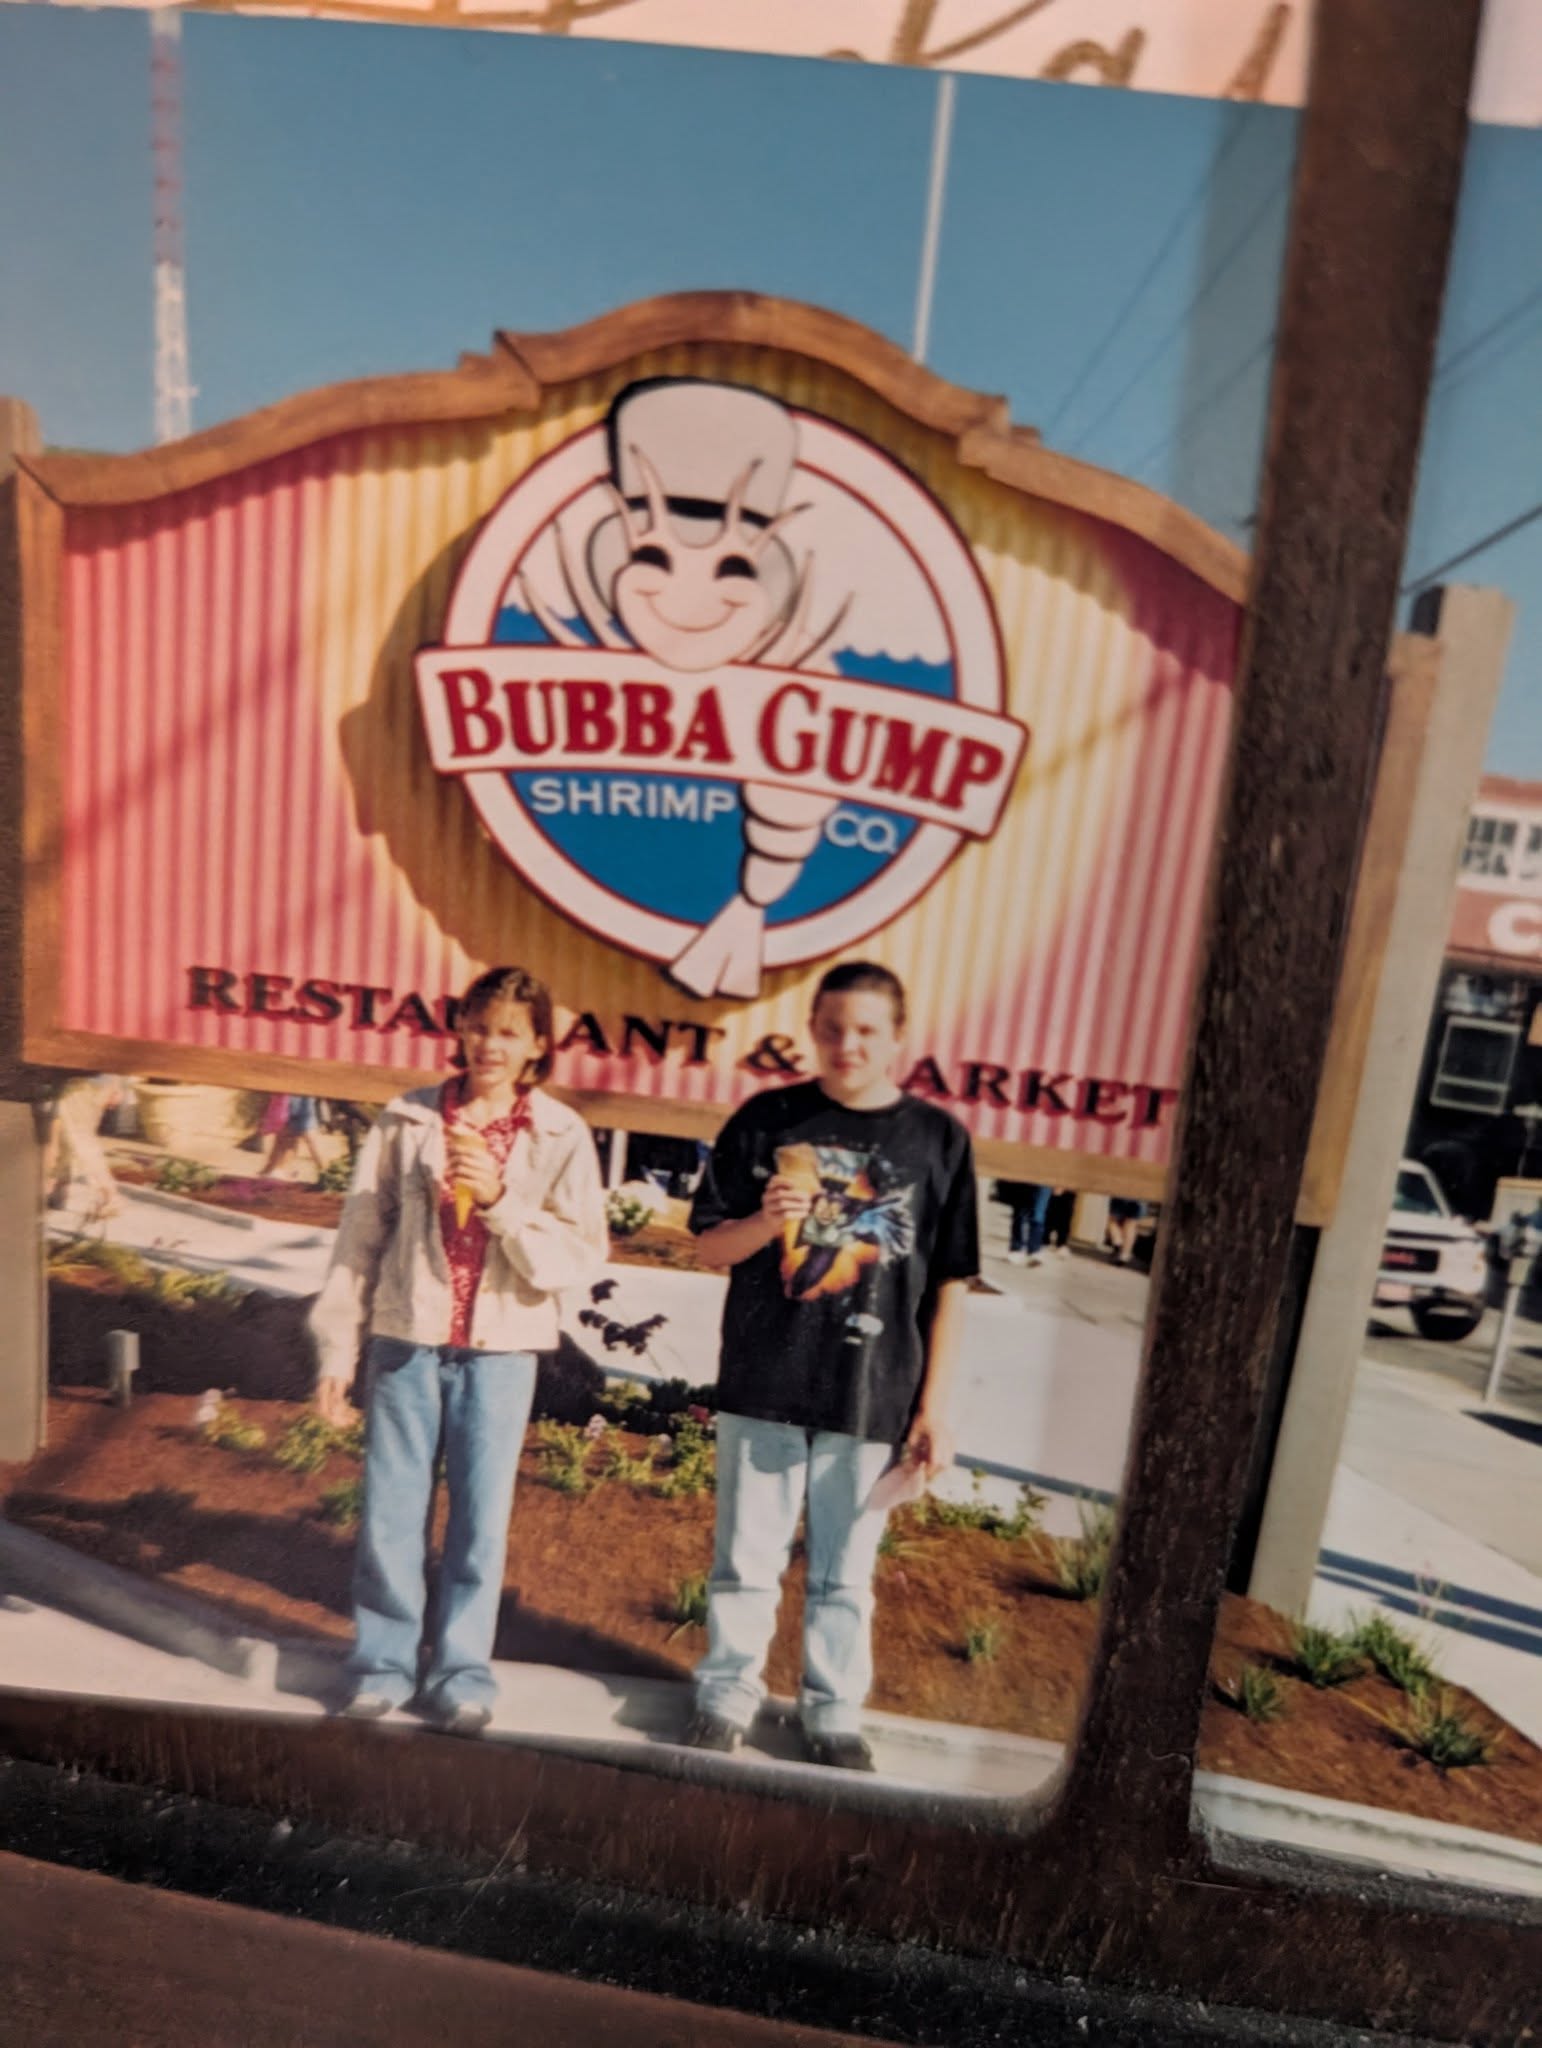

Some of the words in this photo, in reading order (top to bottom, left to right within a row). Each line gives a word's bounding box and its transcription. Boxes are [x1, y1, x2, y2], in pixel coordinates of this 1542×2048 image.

[437, 667, 735, 763] BUBBA
[756, 682, 1004, 811] GUMP
[530, 776, 738, 823] SHRIMP
[185, 966, 727, 1066] RESTAANT
[742, 1032, 804, 1077] &
[882, 1055, 1180, 1130] ARKET
